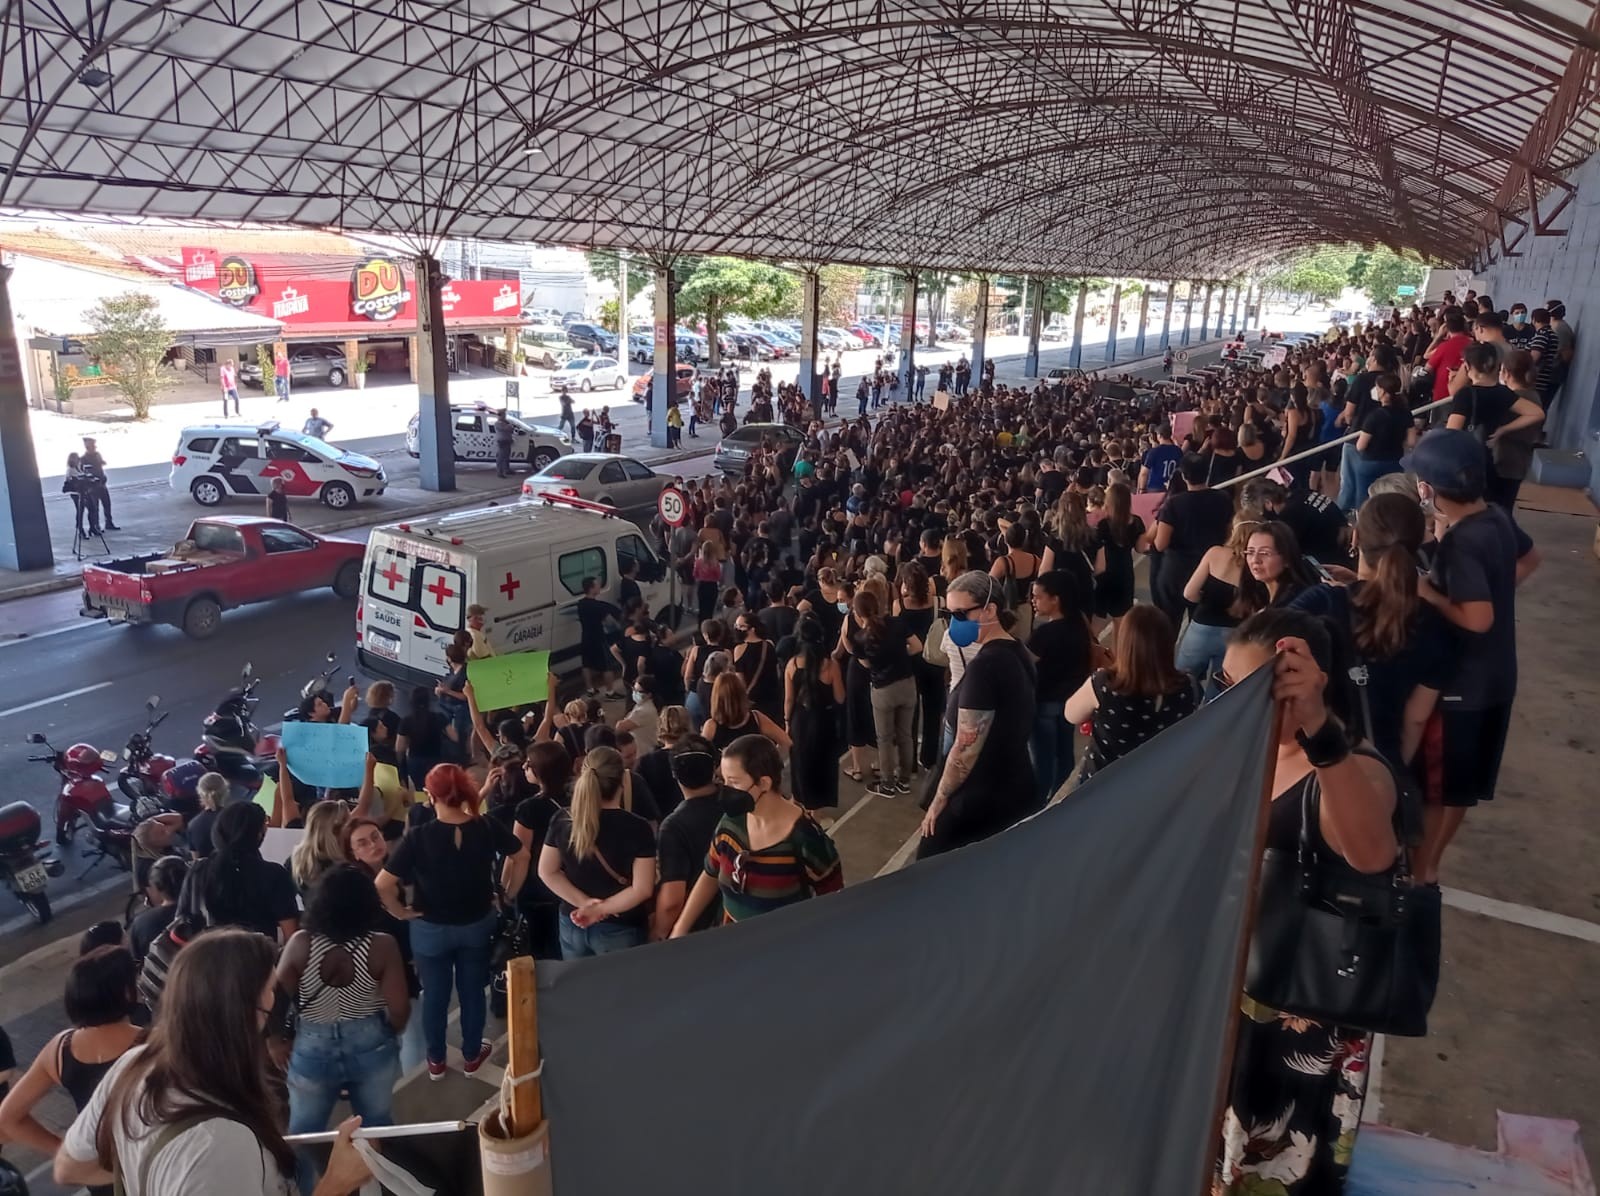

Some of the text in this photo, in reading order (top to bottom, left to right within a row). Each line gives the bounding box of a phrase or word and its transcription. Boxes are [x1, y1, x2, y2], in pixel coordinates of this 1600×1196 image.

[220, 267, 247, 287] DU
[360, 266, 398, 297] DU
[219, 286, 257, 297] Costela
[272, 295, 309, 319] ITAIPAVA
[354, 291, 411, 314] Costela
[466, 450, 525, 459] POLIA
[1163, 460, 1176, 480] 10
[665, 496, 681, 514] 50
